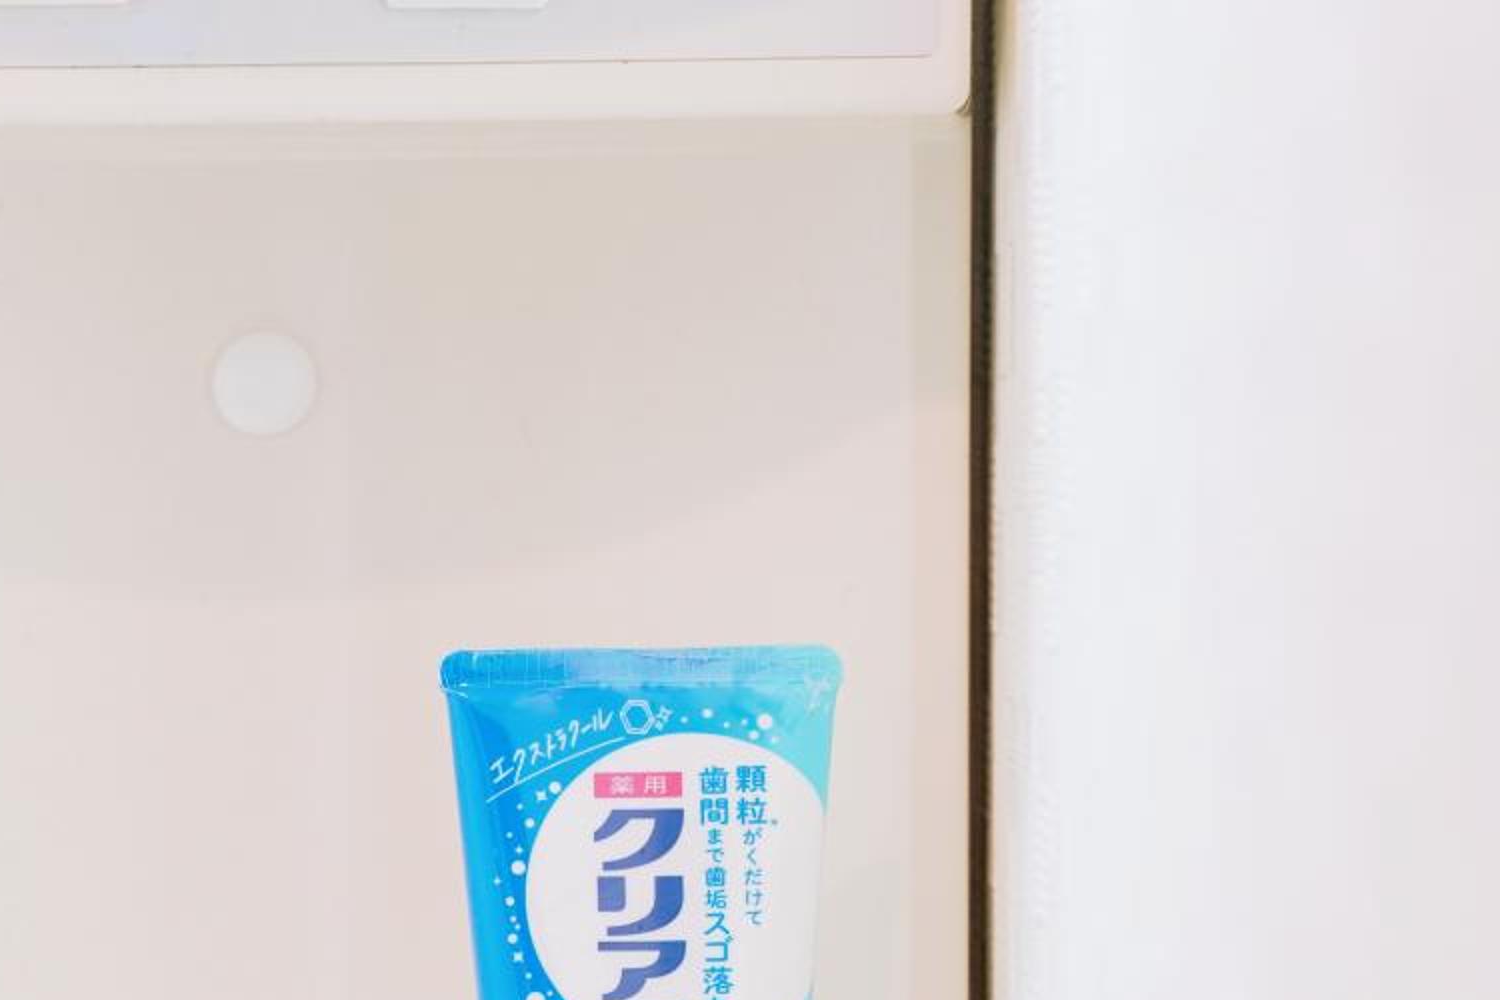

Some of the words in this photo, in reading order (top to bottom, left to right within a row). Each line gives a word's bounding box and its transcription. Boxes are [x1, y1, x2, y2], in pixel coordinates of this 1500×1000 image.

[489, 708, 618, 786] エクストラクール
[610, 774, 668, 795] 薬用
